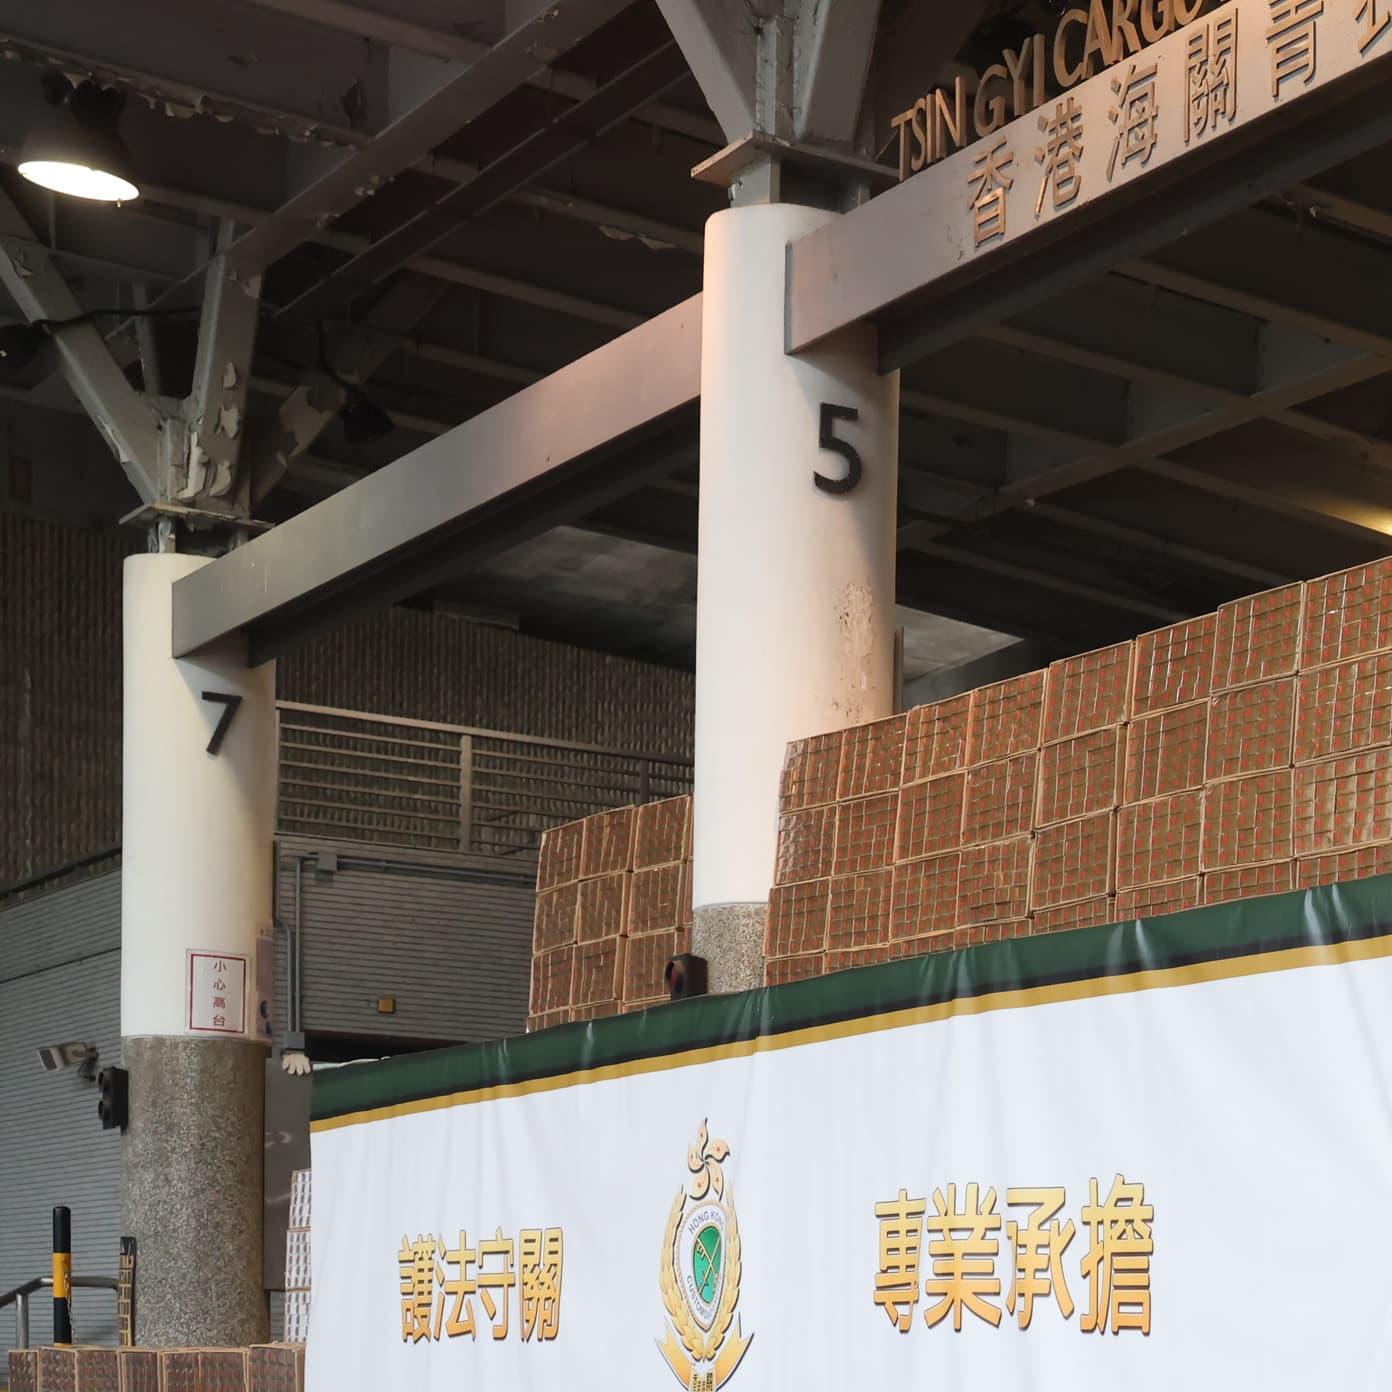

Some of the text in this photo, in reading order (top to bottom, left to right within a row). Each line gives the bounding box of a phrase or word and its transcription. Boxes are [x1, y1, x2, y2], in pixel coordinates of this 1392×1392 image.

[813, 402, 863, 495] 5
[202, 691, 243, 757] 7
[212, 959, 227, 1027] 小心高台
[398, 1226, 564, 1343] 護法守關
